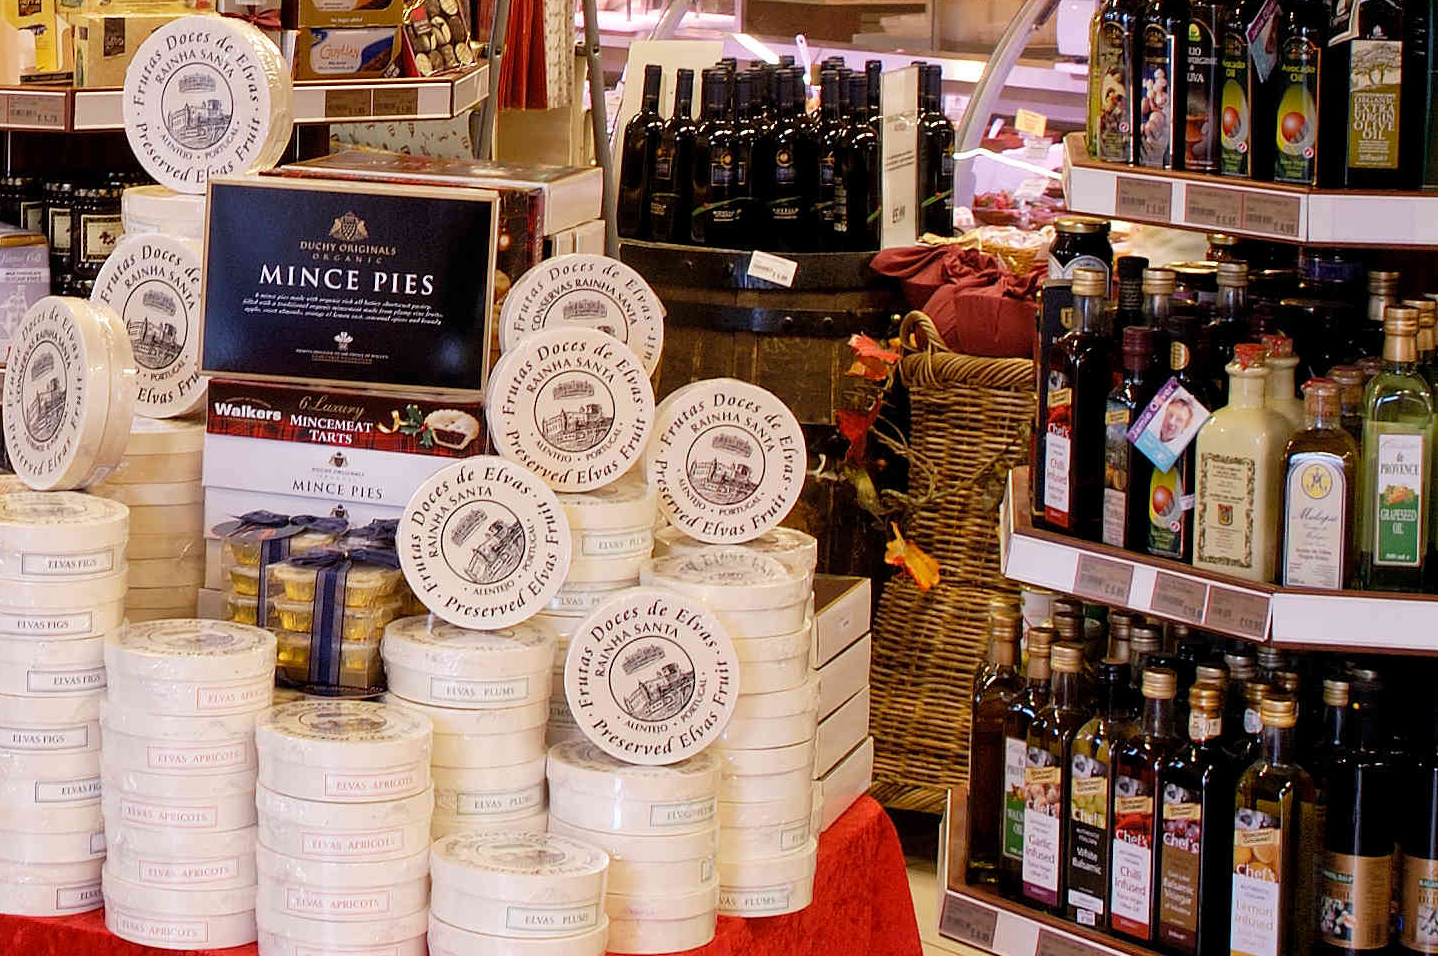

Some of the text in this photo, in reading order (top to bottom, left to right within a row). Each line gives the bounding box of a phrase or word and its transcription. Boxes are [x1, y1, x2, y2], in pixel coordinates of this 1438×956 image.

[133, 31, 259, 106] Frutas Doces de Elvas
[155, 48, 235, 84] RAINHA SANTA
[1281, 64, 1315, 73] Avocado
[1354, 103, 1395, 114] EXTRA
[1354, 121, 1395, 132] OLIVE
[1362, 131, 1386, 140] OIL
[136, 118, 261, 182] Preserved Fruit
[300, 241, 397, 256] DUCHY ORIGINALS
[312, 253, 383, 264] ORGANIC
[100, 244, 202, 304] Frutas Doces de
[259, 264, 434, 296] MINCE PIES
[124, 265, 195, 311] RAINHA SANTA
[514, 262, 652, 334] Frutas Doces de Elvas
[531, 279, 638, 331] CONSERVAS RAINHA SANTA
[502, 340, 644, 416] Frutas Doces de Elvas
[526, 357, 614, 394] RAINHA SANTA
[137, 386, 174, 405] Elvas
[214, 402, 282, 421] Walkers
[298, 395, 365, 421] 6 Luxury
[289, 415, 374, 433] MINCEMEAT
[690, 411, 775, 453] RAINHA SANTA
[308, 430, 352, 444] TARTS
[661, 393, 799, 484] Frutas Doces de Elvas
[506, 418, 646, 484] Preserved Elvas Fruit
[1380, 463, 1420, 476] PROVENCE
[292, 479, 383, 500] MINCE PIES
[655, 459, 786, 536] Preserved Elvas Fruit
[428, 486, 493, 558] RAINHA SANTA
[1380, 509, 1417, 521] GRAPESEED
[411, 466, 532, 593] Frutas Doces de Elvas
[1392, 523, 1404, 534] OIL
[48, 558, 97, 569] ELVAS FIGS
[444, 501, 559, 618] Preserved Elvas Fruit
[17, 619, 69, 629] ELVAS FIGS
[577, 599, 718, 709] Frutas Doces de Elvas
[595, 622, 679, 677] RAINHA SANTA
[53, 676, 81, 686] ELVAS
[446, 684, 476, 697] ELVAS
[592, 660, 730, 756] Preserved Elvas Fruit
[12, 733, 66, 744] ELVAS FIGS
[1073, 808, 1105, 830] Chef's
[1115, 829, 1149, 850] Chef's
[1162, 832, 1200, 854] Chef's
[1025, 847, 1055, 864] Infused
[1235, 864, 1278, 883] Chef's
[1114, 877, 1146, 897] Infused
[524, 914, 556, 926] ELVAS
